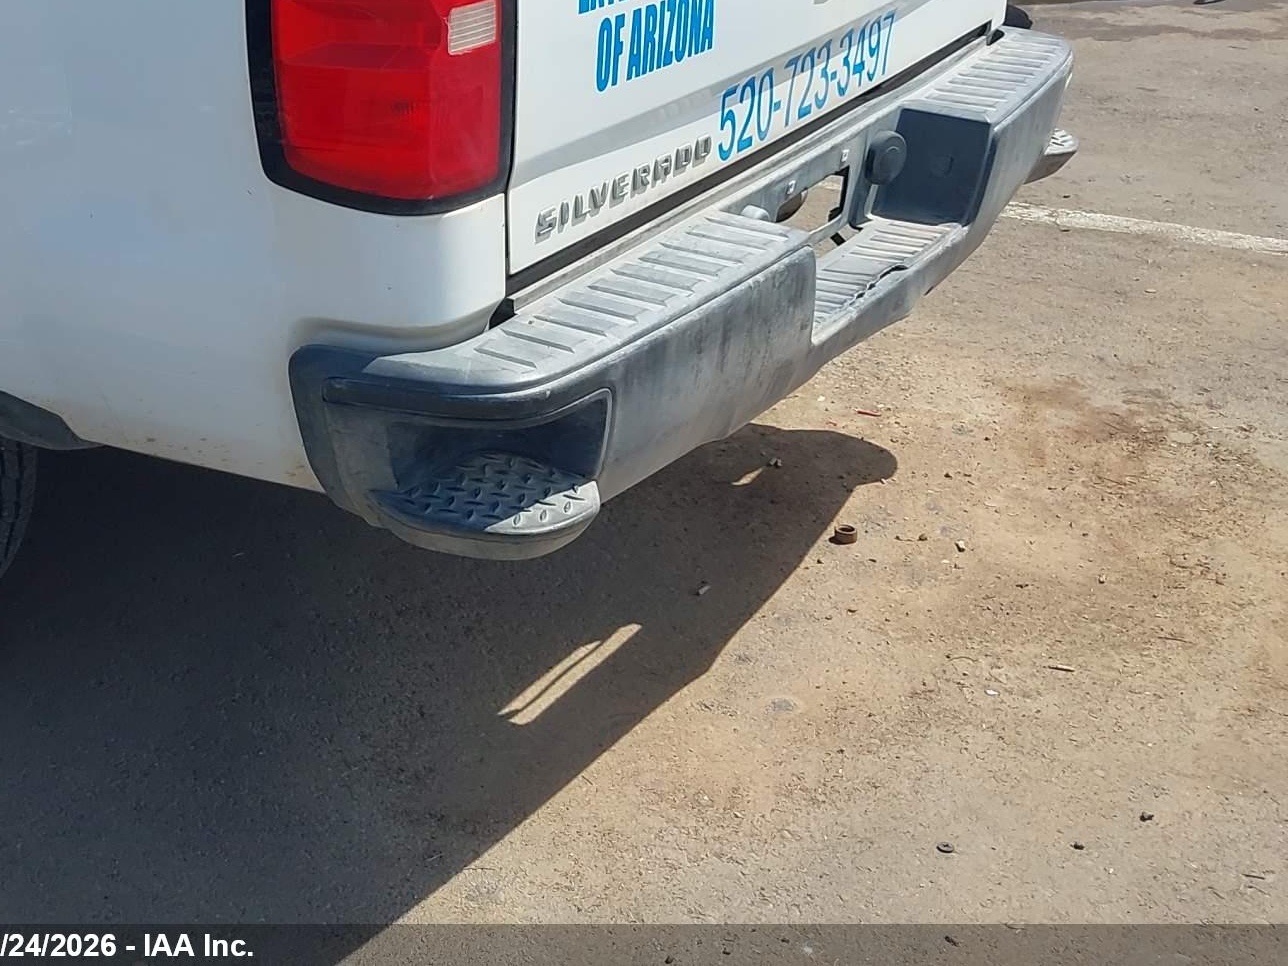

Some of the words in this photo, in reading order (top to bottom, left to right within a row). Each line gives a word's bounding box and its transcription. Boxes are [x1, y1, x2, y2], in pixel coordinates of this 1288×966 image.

[595, 13, 626, 93] OF
[717, 9, 897, 162] 520-723-3497
[535, 135, 712, 243] SILVERADO
